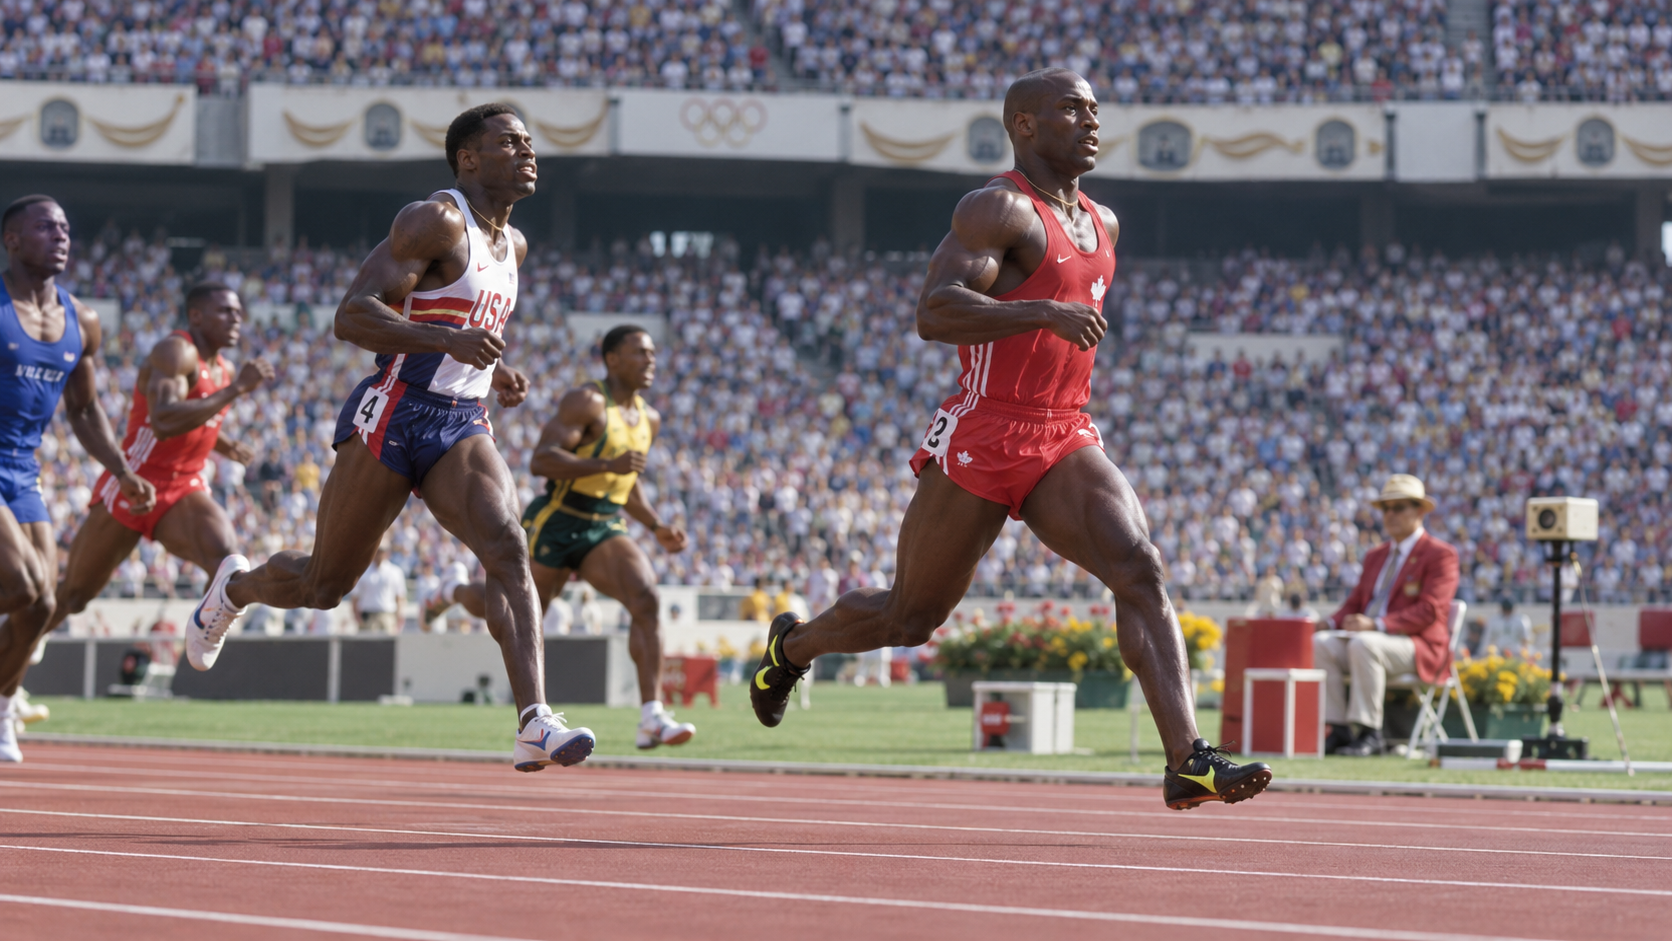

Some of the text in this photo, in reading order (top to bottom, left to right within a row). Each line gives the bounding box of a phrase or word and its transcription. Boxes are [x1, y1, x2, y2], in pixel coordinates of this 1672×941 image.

[469, 290, 511, 333] USA
[361, 395, 378, 423] 4
[928, 417, 947, 448] 2
